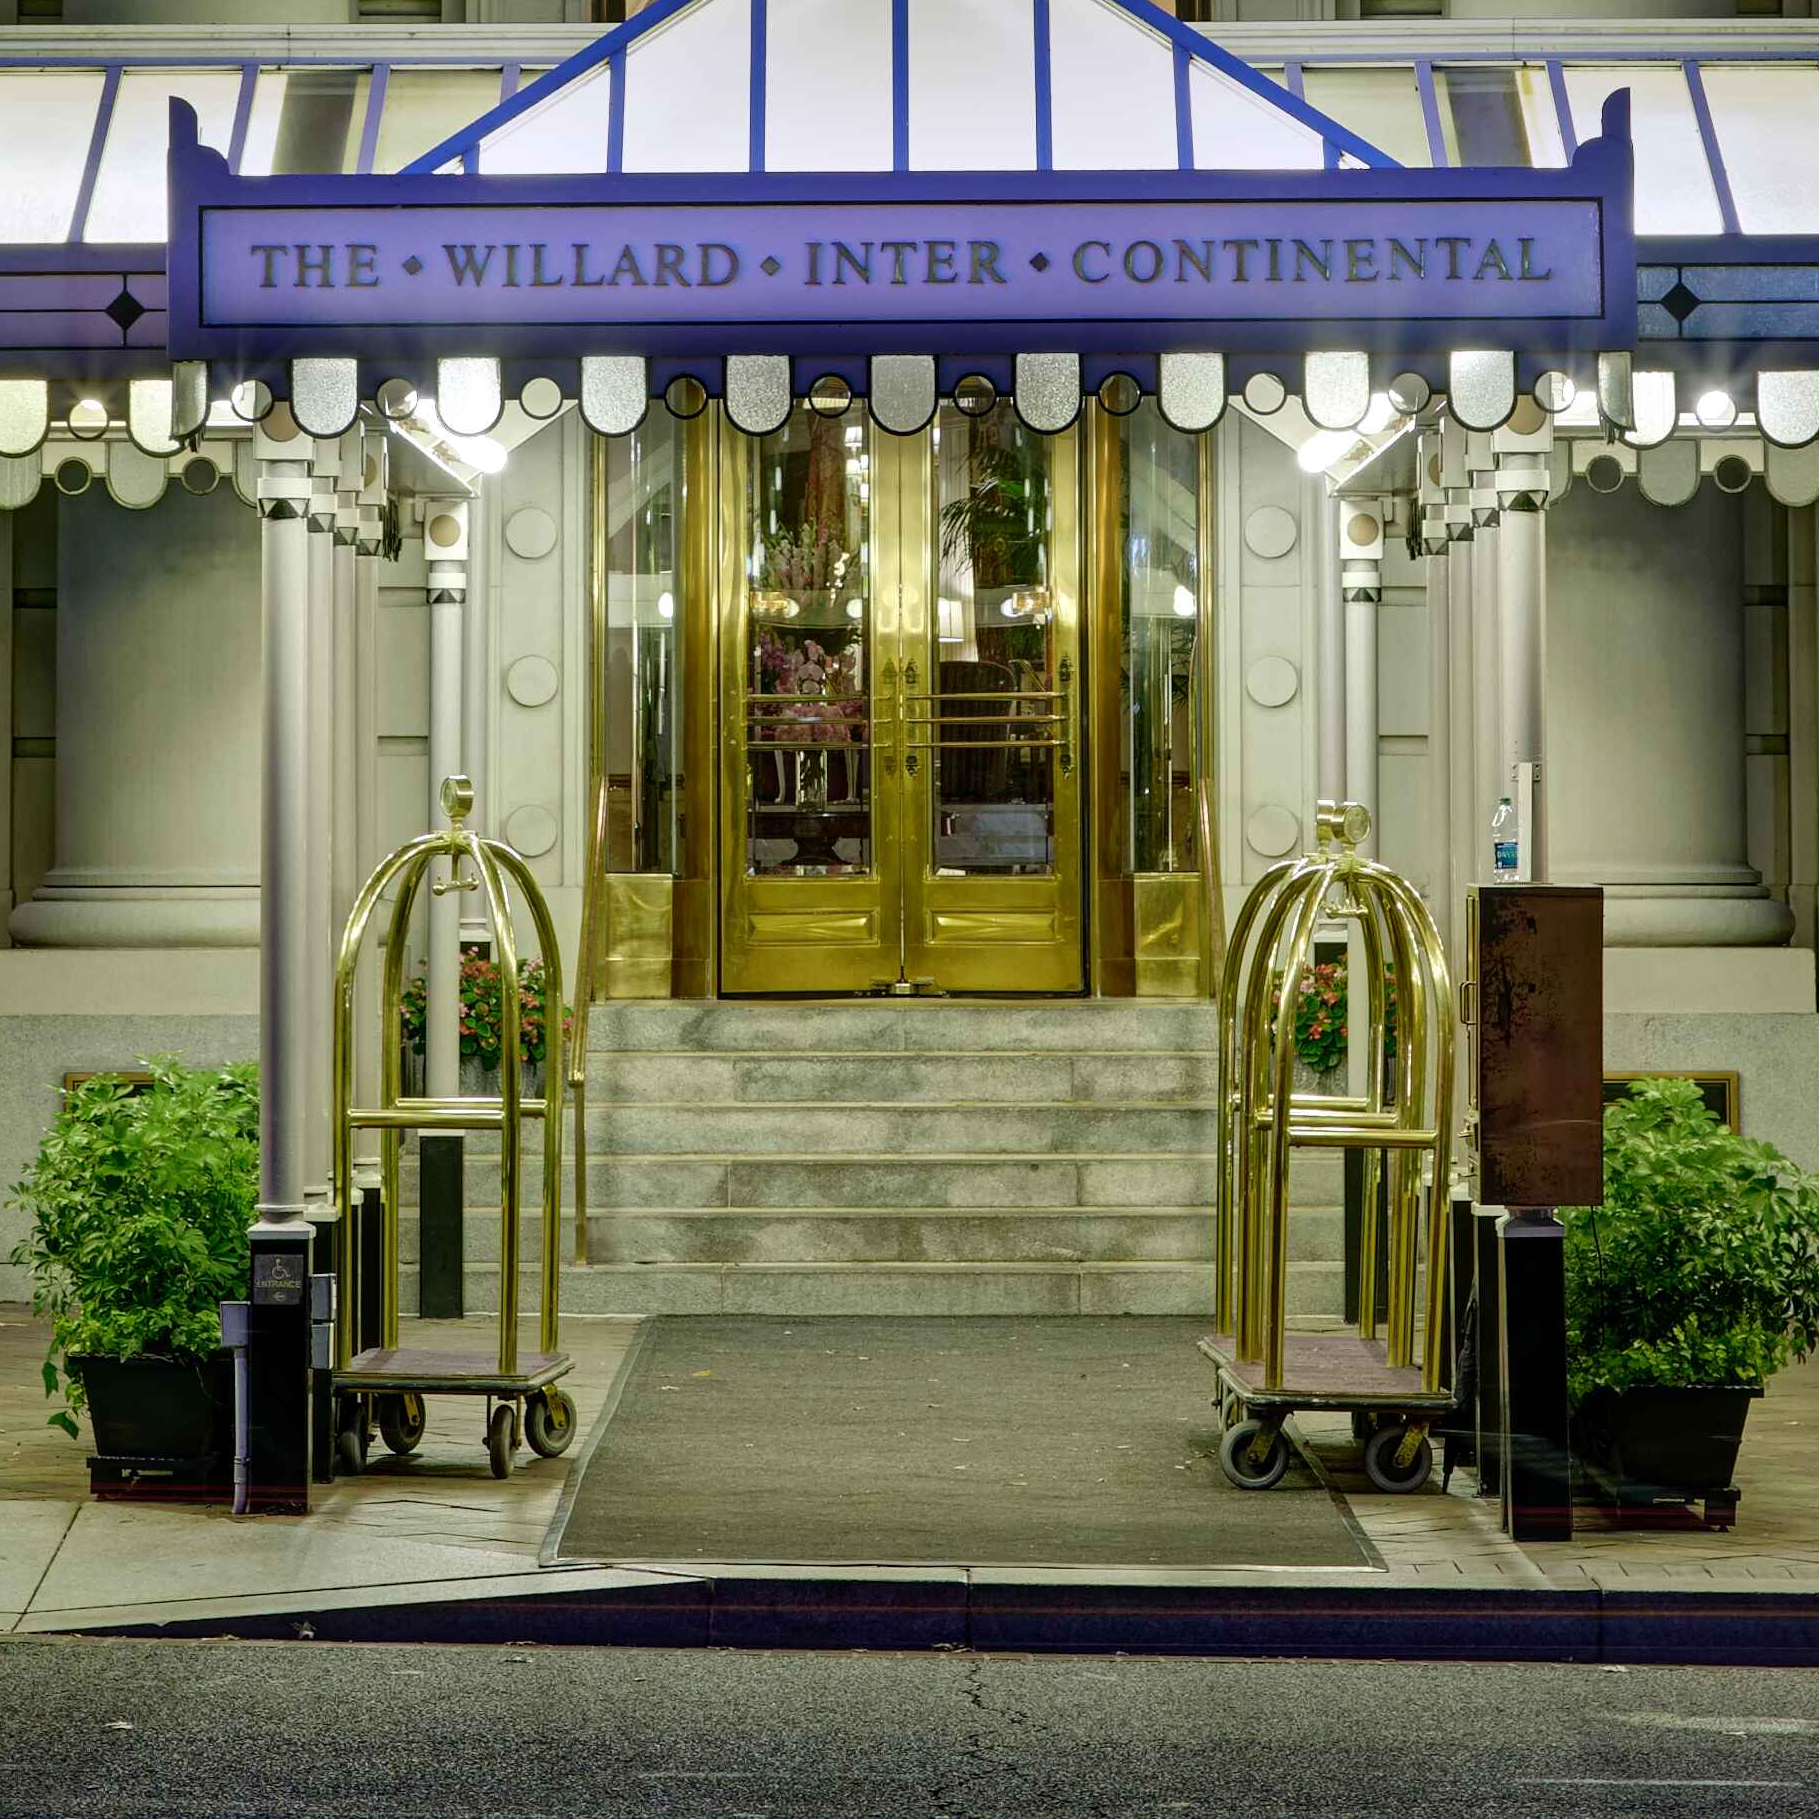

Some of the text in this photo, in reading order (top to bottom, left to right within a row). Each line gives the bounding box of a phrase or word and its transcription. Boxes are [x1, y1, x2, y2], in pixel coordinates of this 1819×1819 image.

[250, 237, 1553, 289] THE WILLARD INTER CONTINENTAL
[254, 1279, 301, 1288] ENTRANCE
